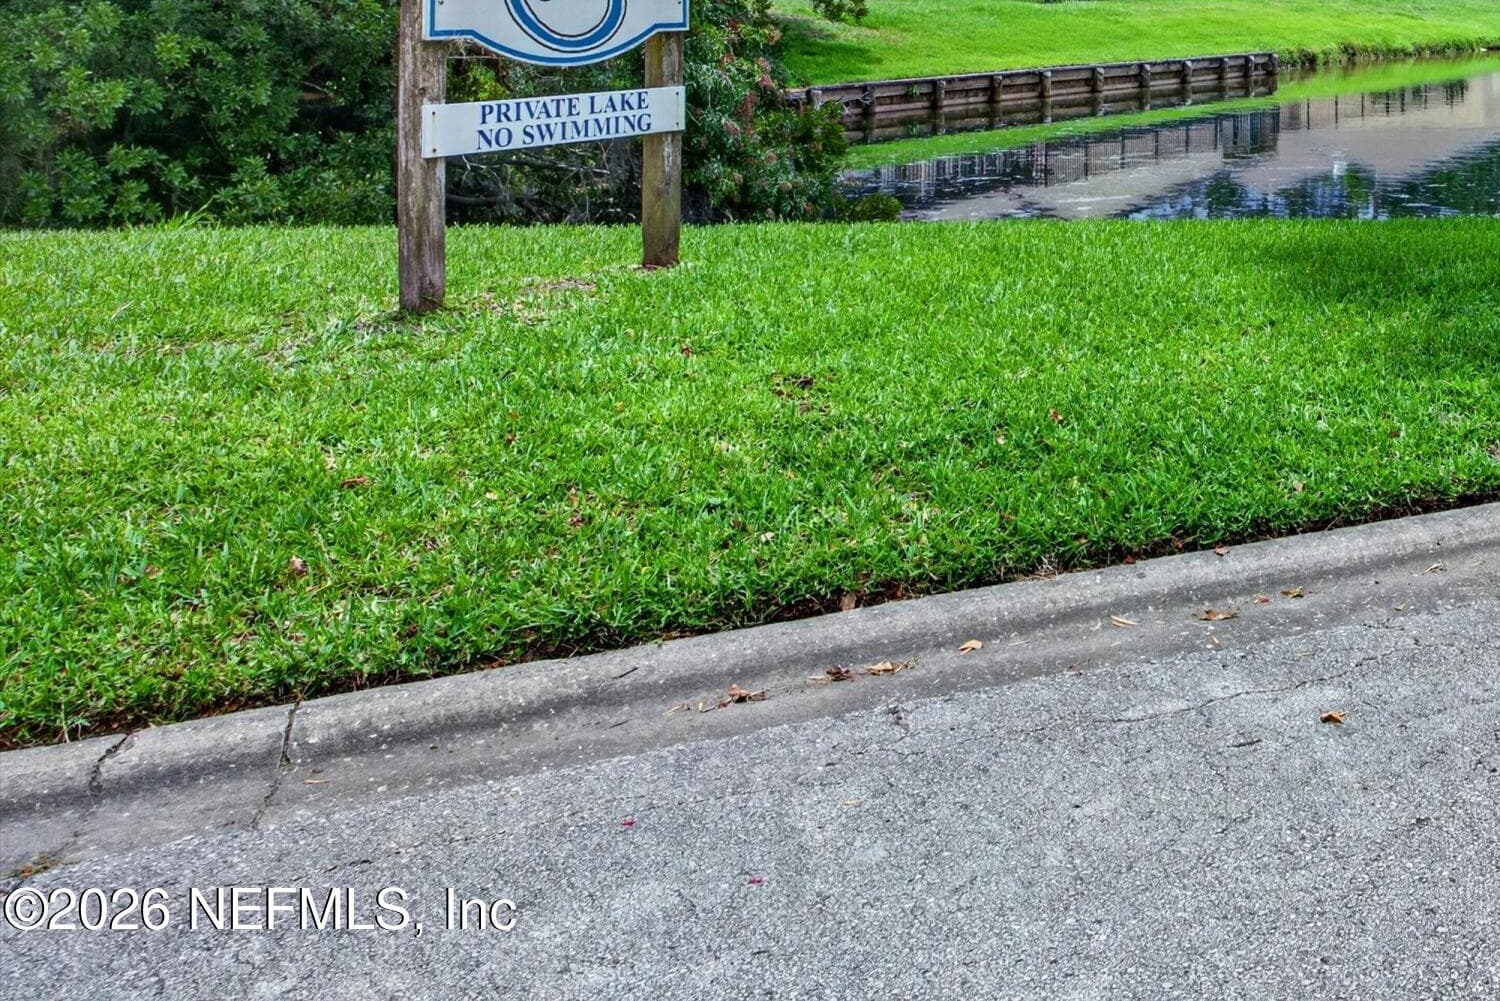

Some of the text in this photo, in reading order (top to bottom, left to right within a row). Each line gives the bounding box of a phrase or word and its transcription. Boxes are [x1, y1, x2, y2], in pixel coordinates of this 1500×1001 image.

[480, 91, 649, 125] PRIVATE LAKE
[476, 113, 652, 150] NO SWIMMING
